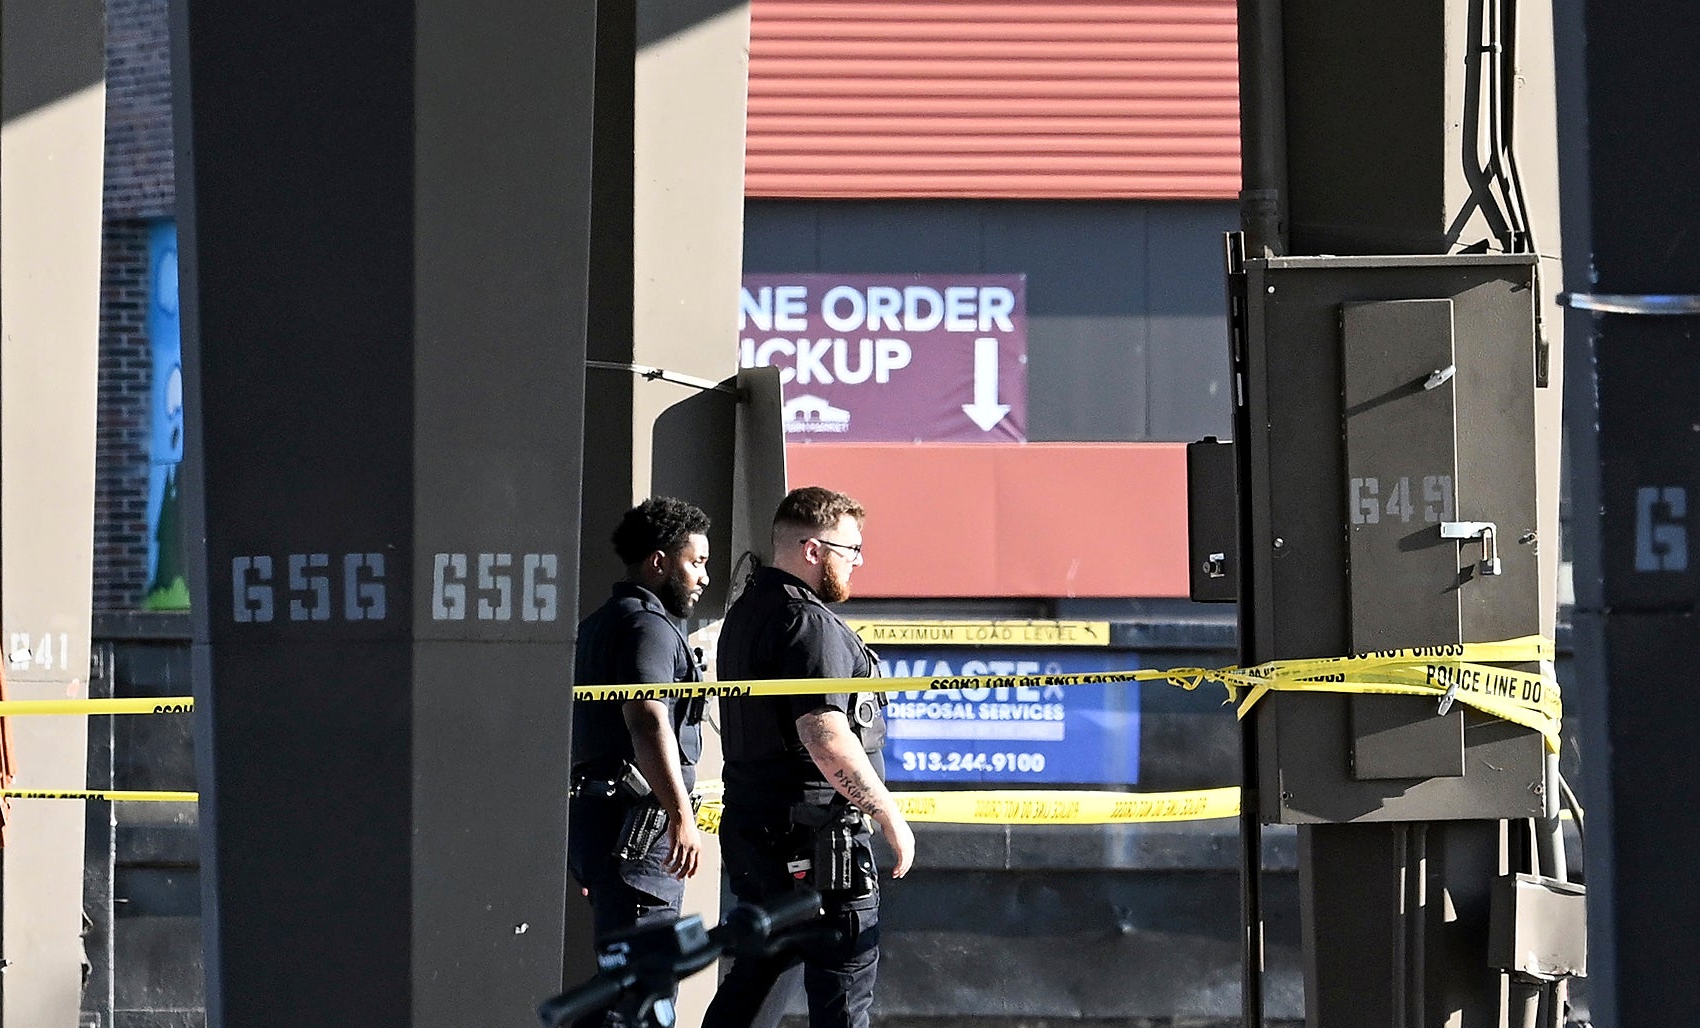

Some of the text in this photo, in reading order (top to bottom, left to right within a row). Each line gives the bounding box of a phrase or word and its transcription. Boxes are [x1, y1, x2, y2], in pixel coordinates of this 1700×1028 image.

[739, 285, 1015, 332] NE ORDER
[741, 337, 912, 384] ICKUP
[873, 627, 1077, 642] MAXIMUM LOAD LEVEL
[878, 659, 1042, 703] WASTE
[1426, 664, 1542, 703] POLICE LINE DO
[886, 702, 1065, 722] DISPOSAL SERVICES
[902, 751, 1046, 774] 313.244.9100
